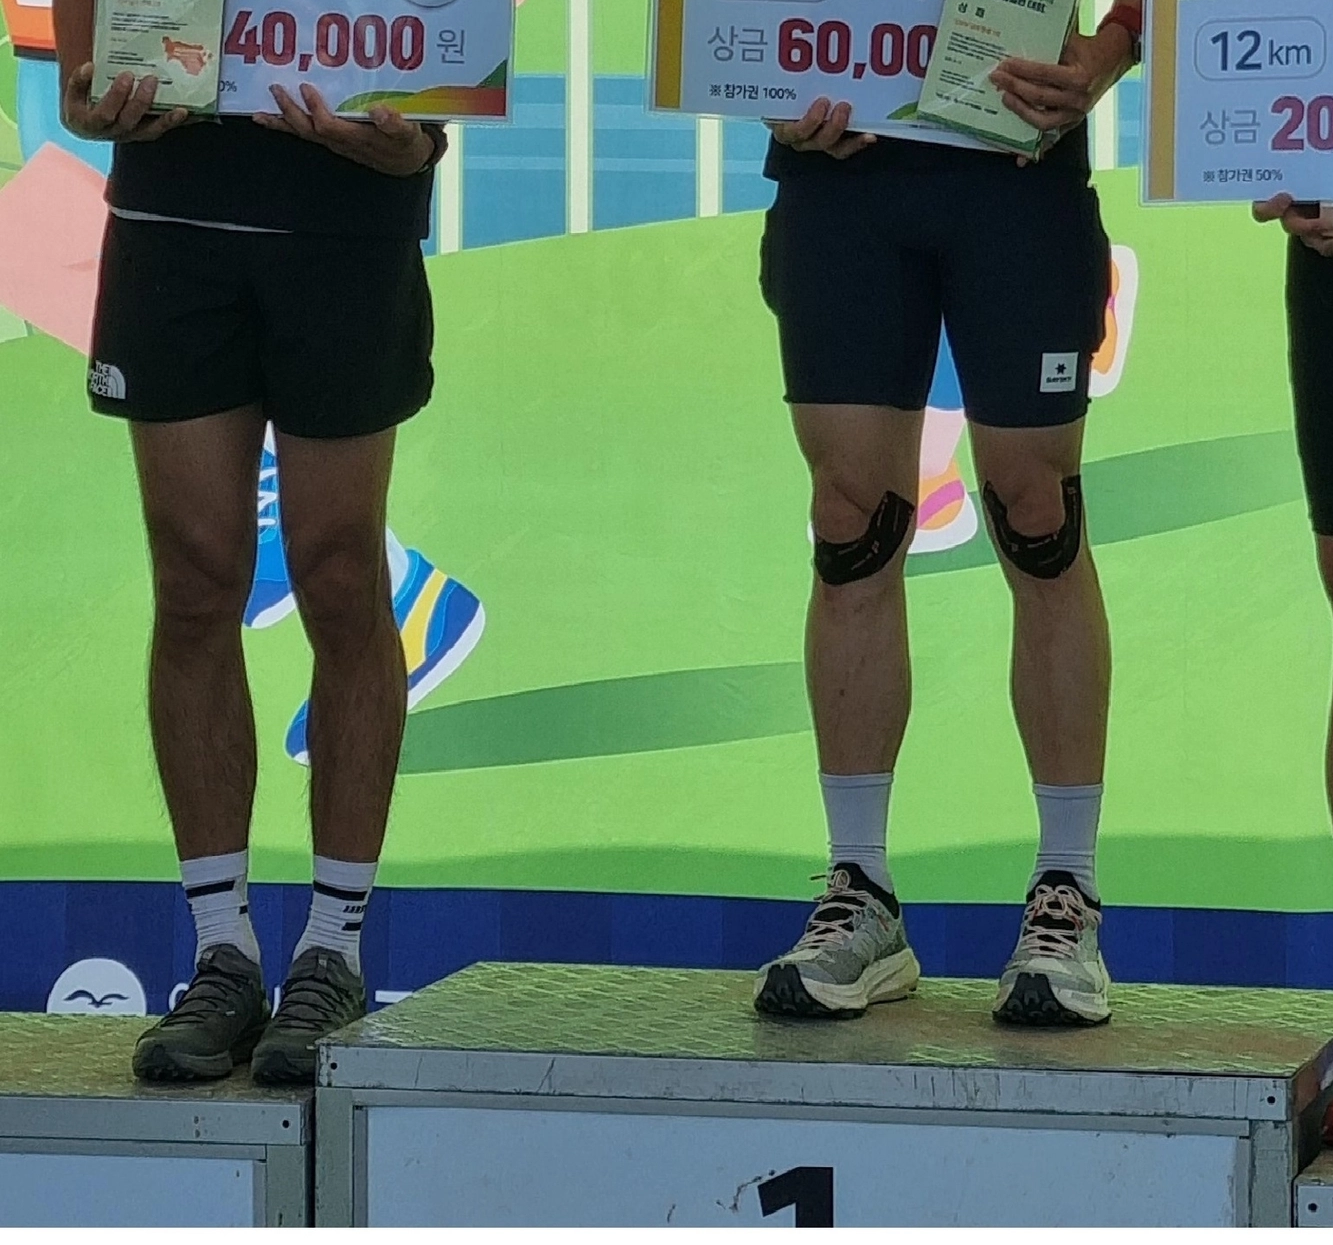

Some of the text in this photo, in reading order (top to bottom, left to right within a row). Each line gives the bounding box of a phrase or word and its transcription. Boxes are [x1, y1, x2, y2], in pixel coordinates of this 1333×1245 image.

[224, 9, 426, 73] 40,000
[436, 28, 466, 66] 원
[707, 24, 769, 64] 상금
[777, 17, 939, 81] 60,00
[1210, 30, 1262, 72] 12
[1268, 39, 1312, 66] km
[723, 83, 759, 100] 참가권
[762, 86, 797, 100] 100%
[1200, 109, 1261, 145] 상금
[1217, 168, 1253, 183] 참가권
[1255, 168, 1283, 182] 50%
